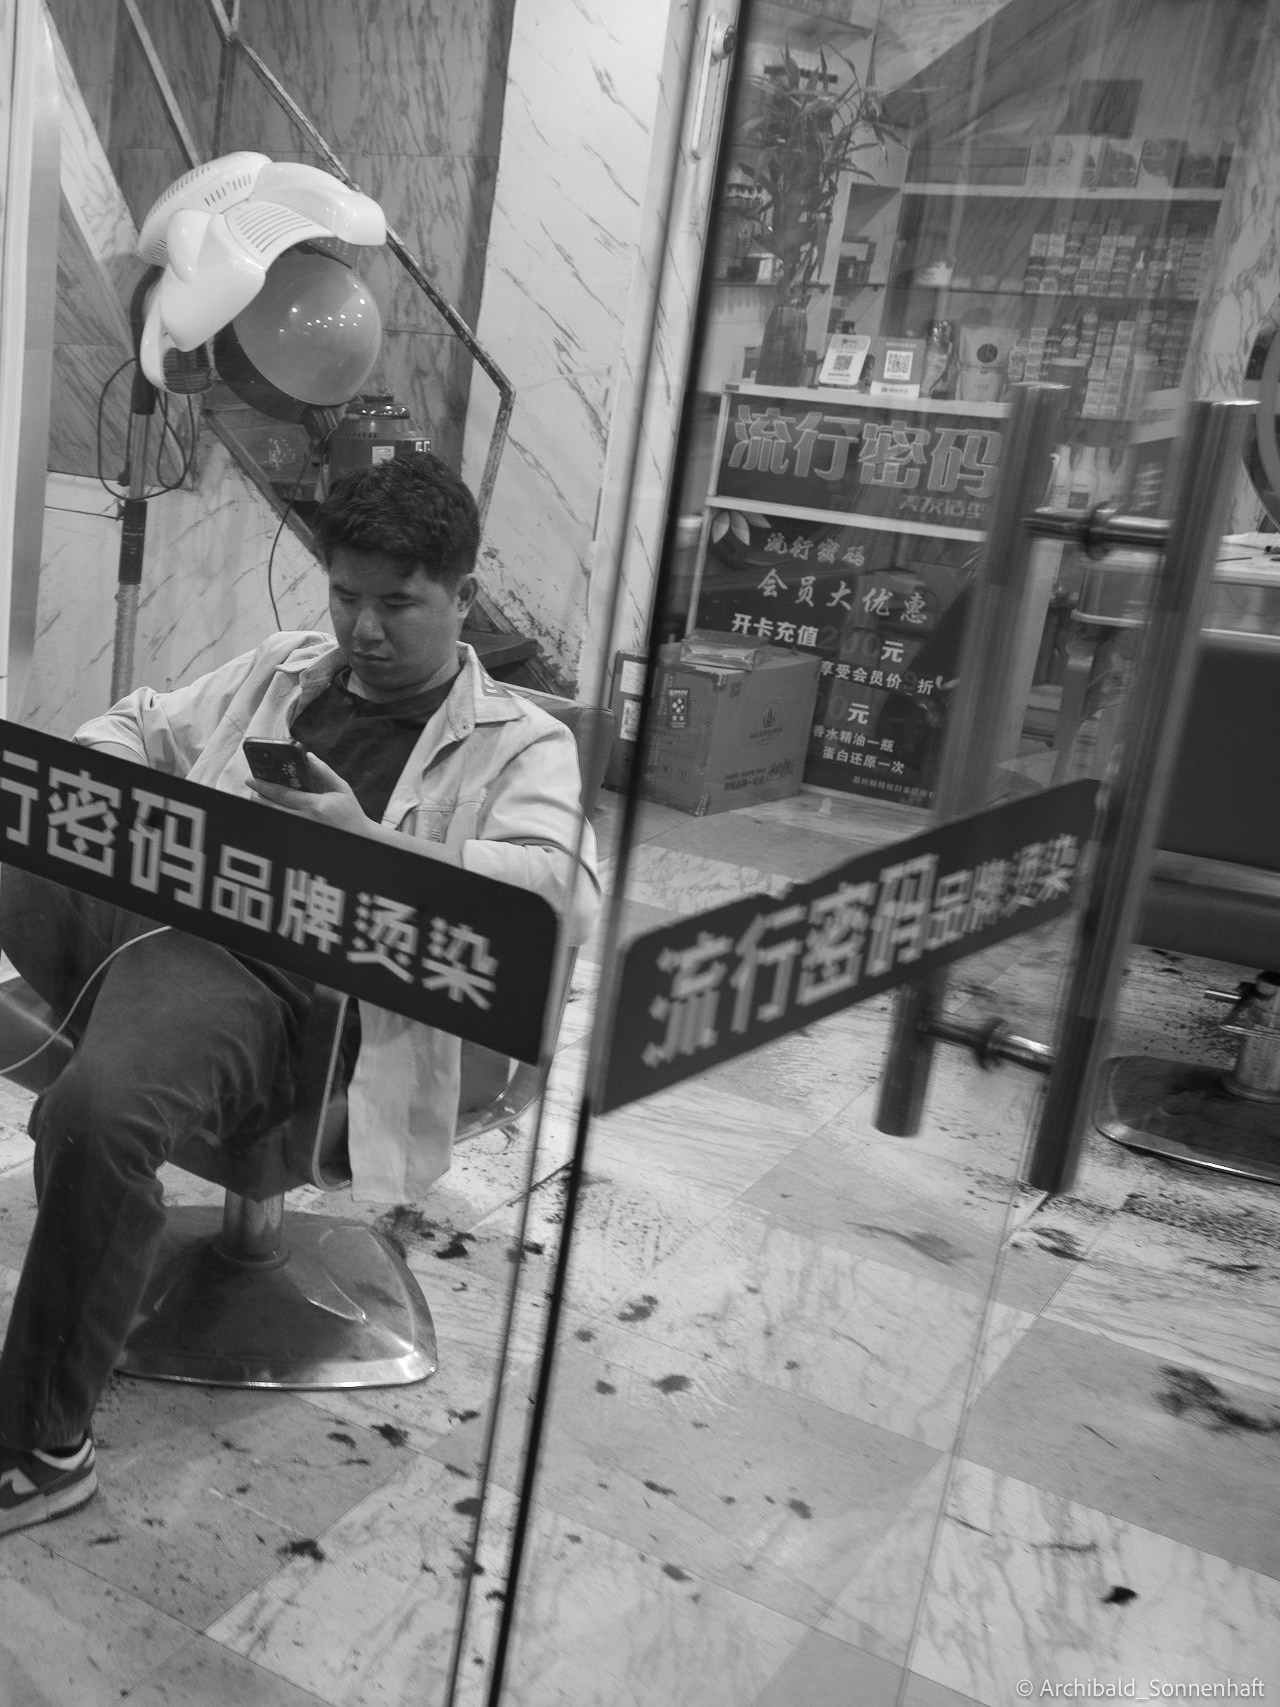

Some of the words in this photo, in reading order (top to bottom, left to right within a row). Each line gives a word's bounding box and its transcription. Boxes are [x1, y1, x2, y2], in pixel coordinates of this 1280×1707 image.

[728, 403, 1003, 499] 流行密码
[763, 532, 866, 567] 流行密码
[756, 567, 929, 625] 会员大优惠
[812, 724, 895, 753] 香水精油一瓶
[822, 745, 905, 775] 蛋白还原一次
